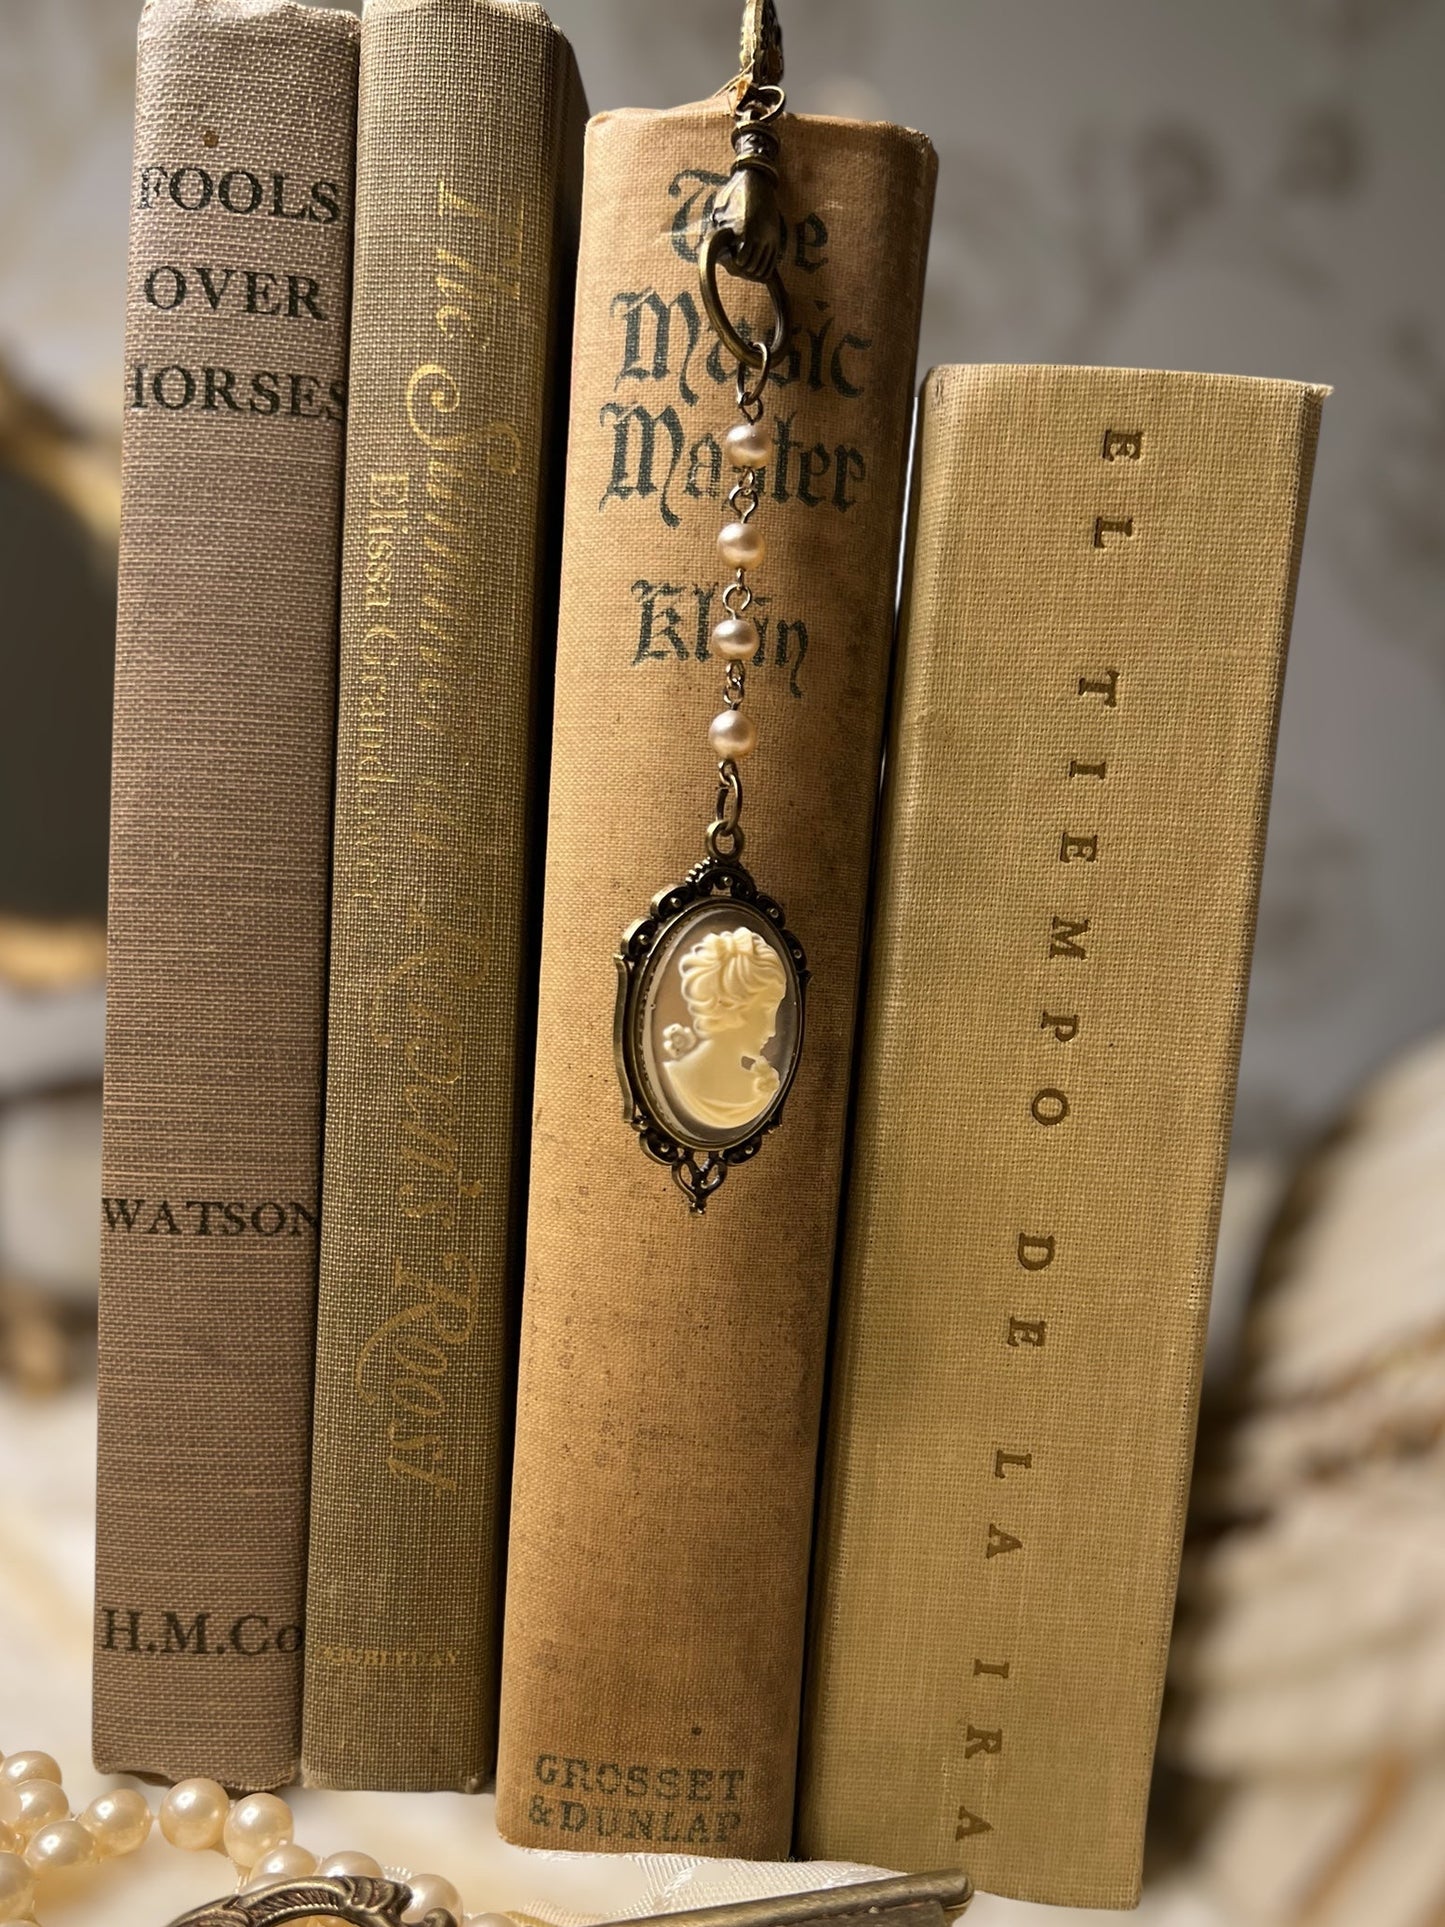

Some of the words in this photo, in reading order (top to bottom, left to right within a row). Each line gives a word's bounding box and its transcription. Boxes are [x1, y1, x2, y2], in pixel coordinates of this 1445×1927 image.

[137, 166, 340, 224] FOOLS
[668, 169, 829, 275] Te
[144, 265, 328, 321] OVER
[436, 180, 523, 352] The
[365, 473, 410, 612] Elissa
[1093, 429, 1143, 549] EL
[406, 363, 521, 765] Summer
[631, 579, 809, 699] Klin
[1031, 670, 1120, 1127] TIEMPO
[370, 895, 490, 1229] Raven's
[1006, 1232, 1056, 1347] DE
[353, 1252, 479, 1497] Roost
[986, 1449, 1033, 1560] LA
[535, 1753, 745, 1803] GROSSET
[955, 1658, 1010, 1842] IRA
